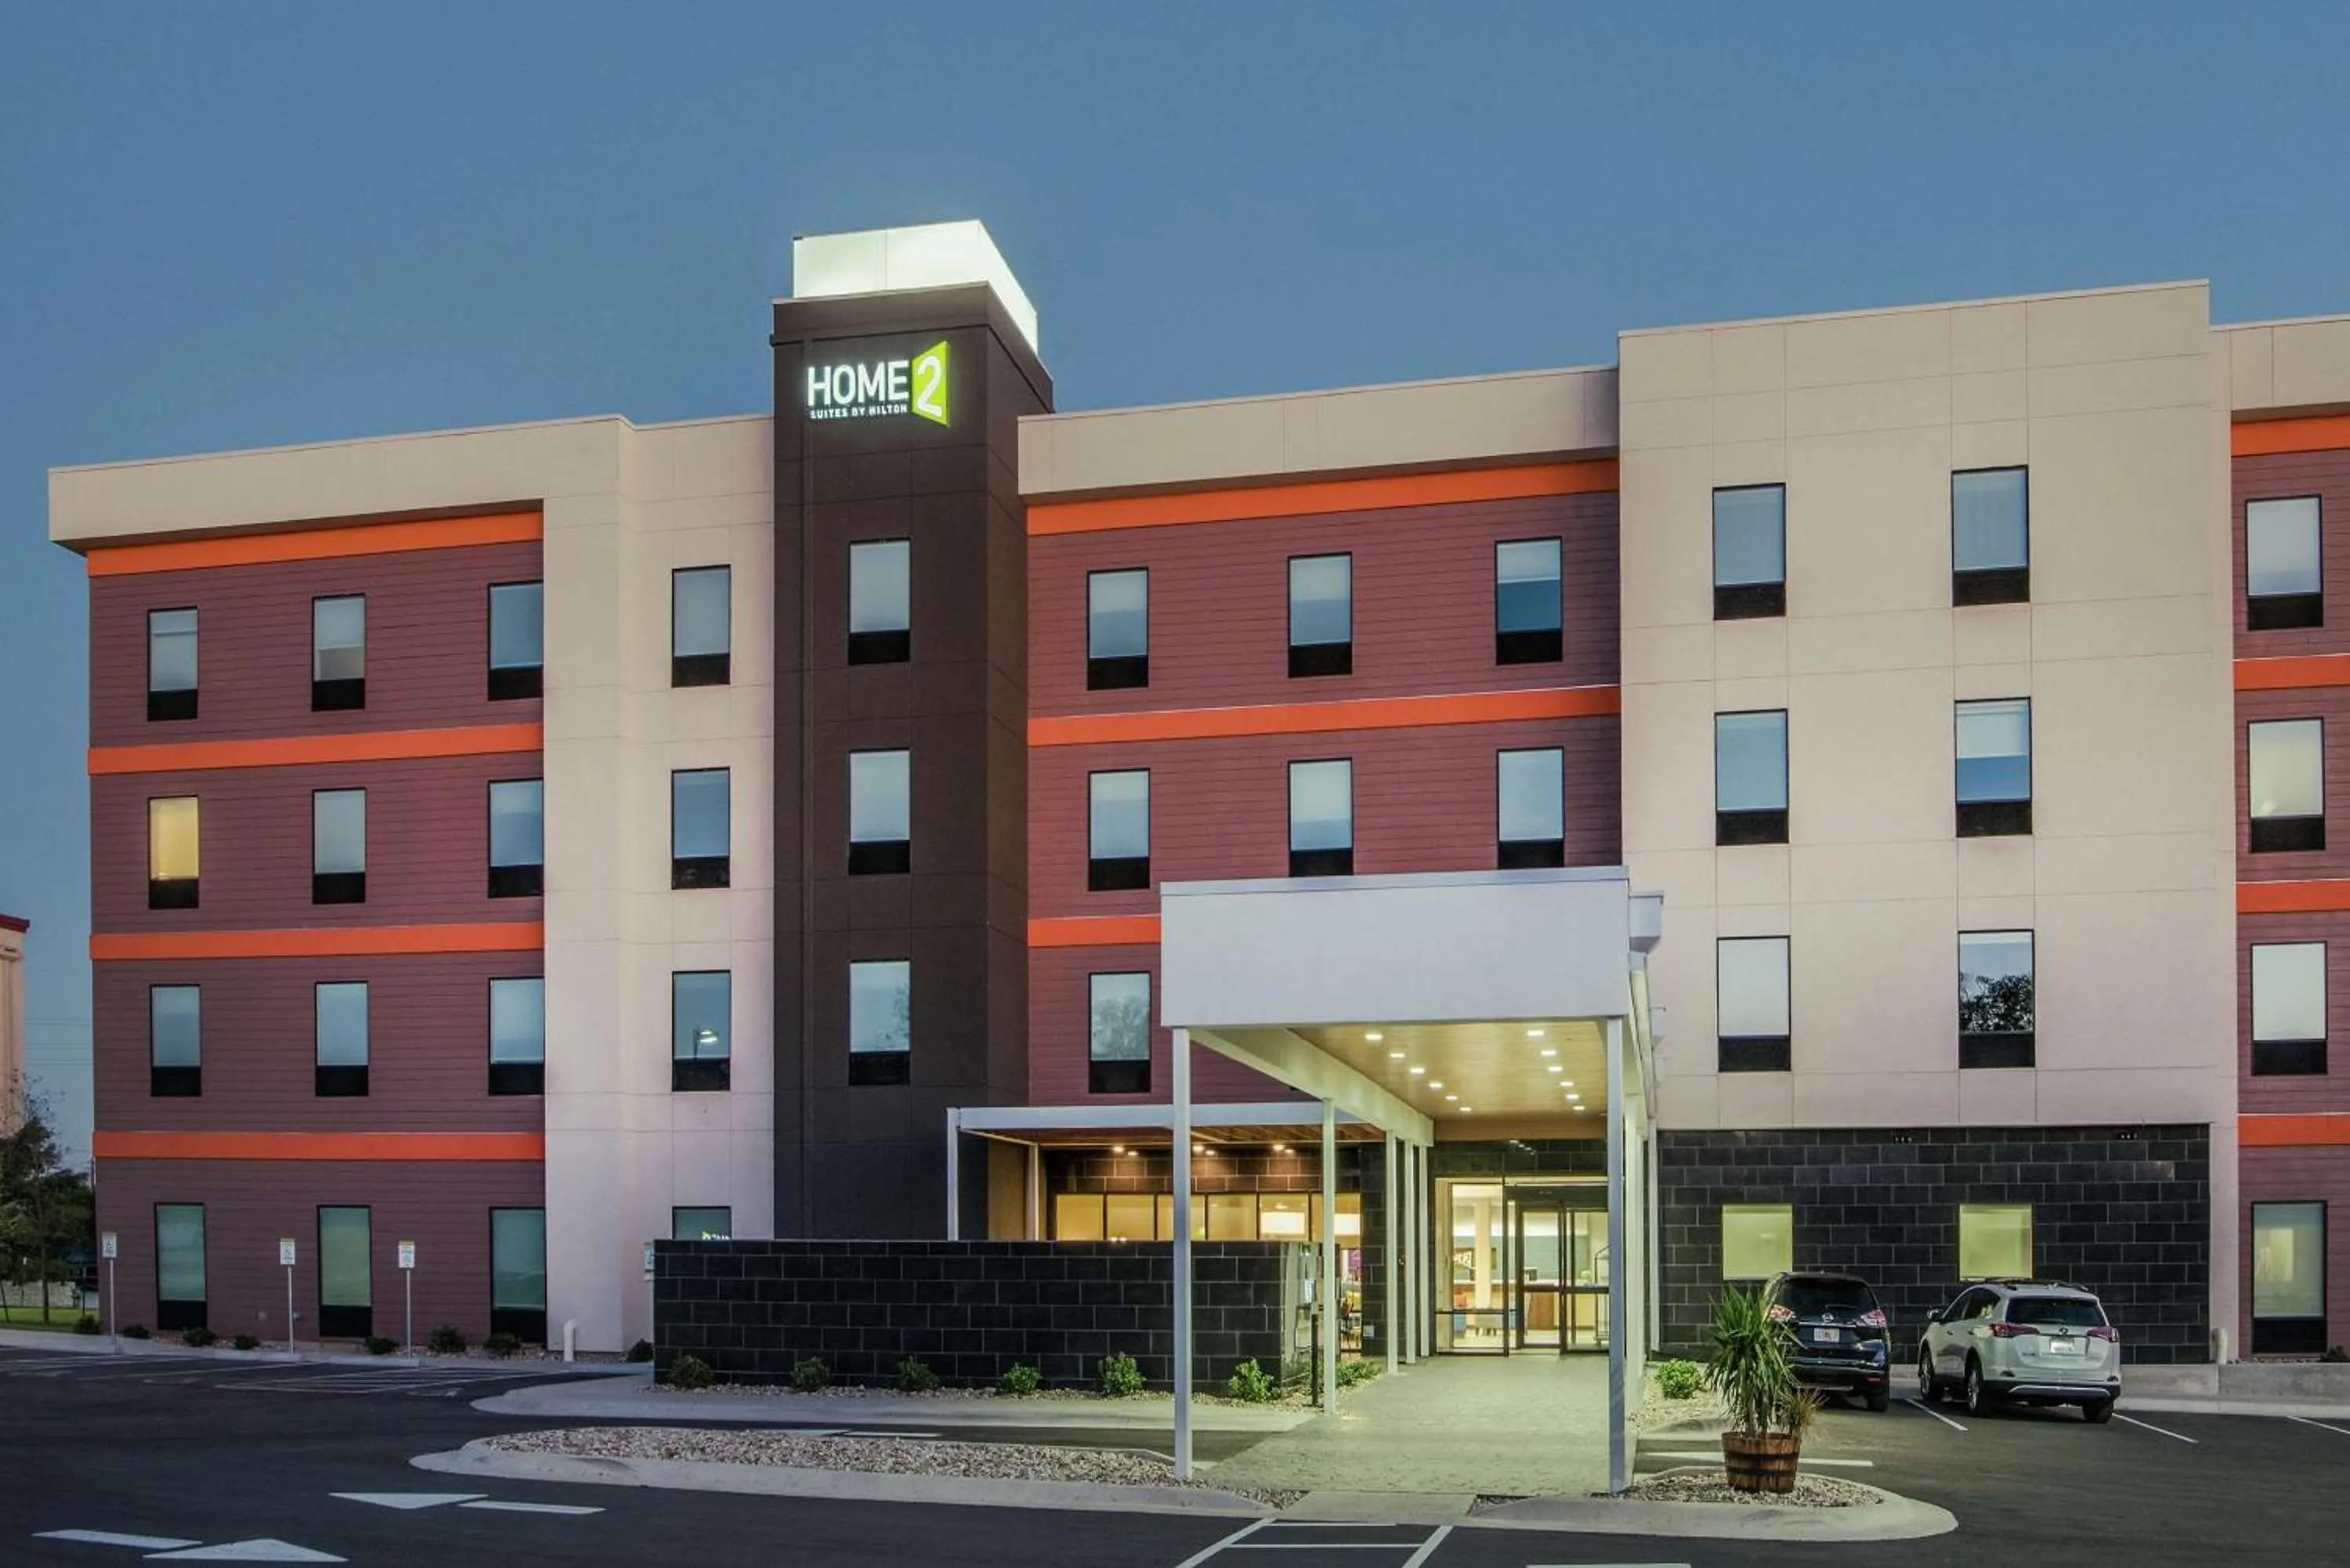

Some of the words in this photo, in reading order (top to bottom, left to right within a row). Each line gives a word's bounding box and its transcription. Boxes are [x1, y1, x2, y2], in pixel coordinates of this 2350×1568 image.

[807, 359, 909, 406] HOME
[916, 356, 943, 417] 2
[810, 408, 848, 419] SUITES
[851, 406, 866, 417] BY
[869, 404, 908, 416] HILTON
